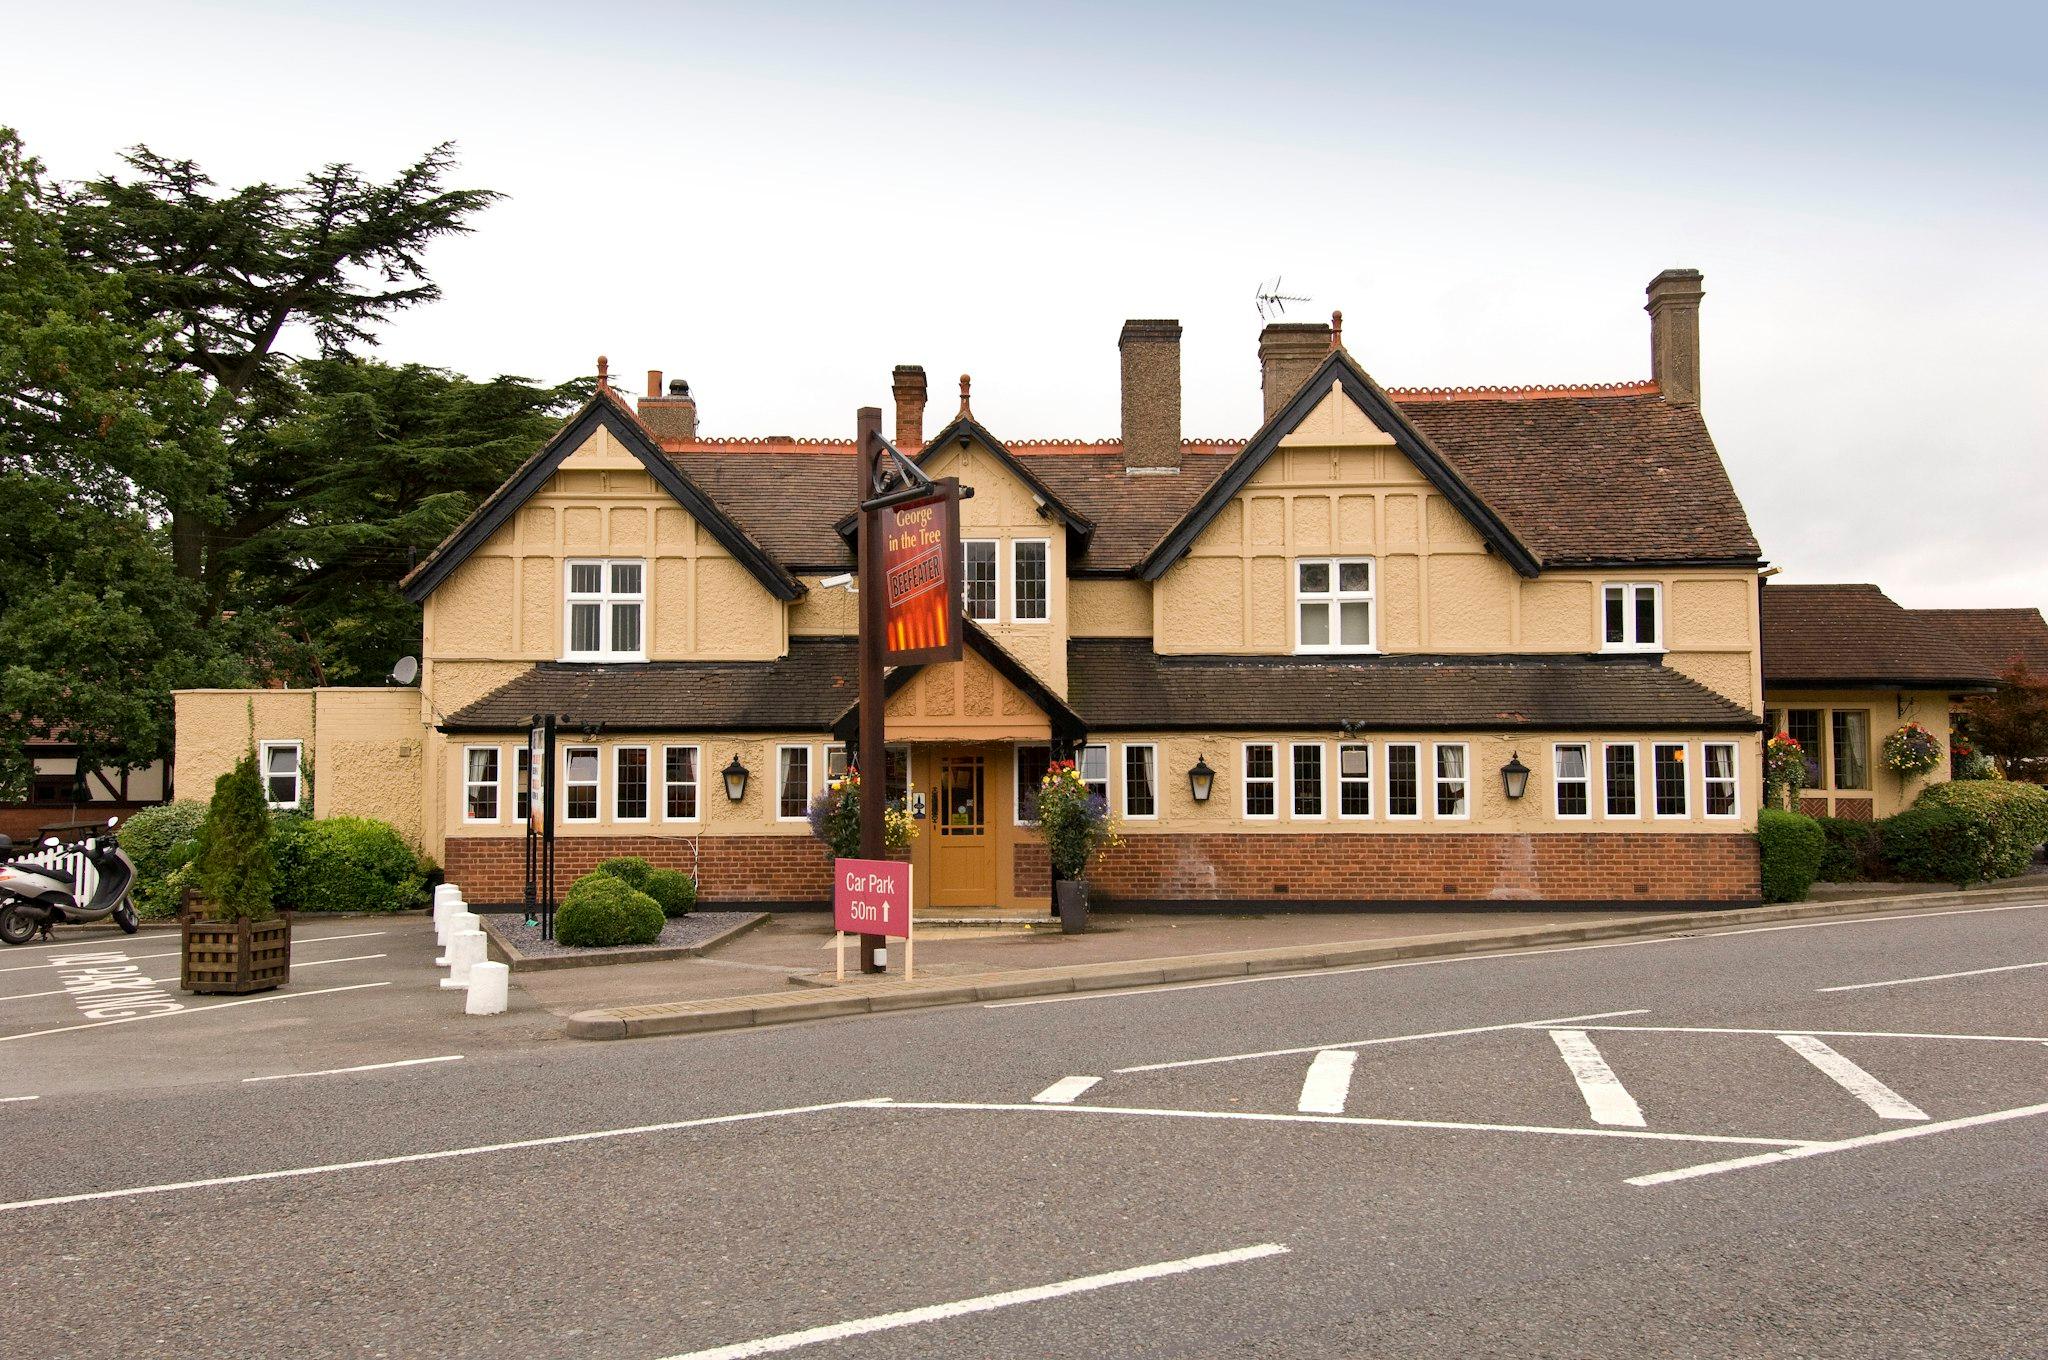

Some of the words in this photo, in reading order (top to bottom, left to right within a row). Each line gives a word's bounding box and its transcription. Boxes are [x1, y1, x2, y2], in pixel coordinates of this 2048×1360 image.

[896, 507, 933, 527] George
[889, 535, 899, 551] in
[901, 531, 917, 549] the
[919, 528, 941, 545] Tree
[892, 556, 940, 597] BEEFEATER
[846, 872, 866, 892] Car
[869, 874, 895, 895] Park
[851, 901, 877, 921] 50m
[47, 951, 130, 966] NO
[57, 966, 185, 1018] PARKING
